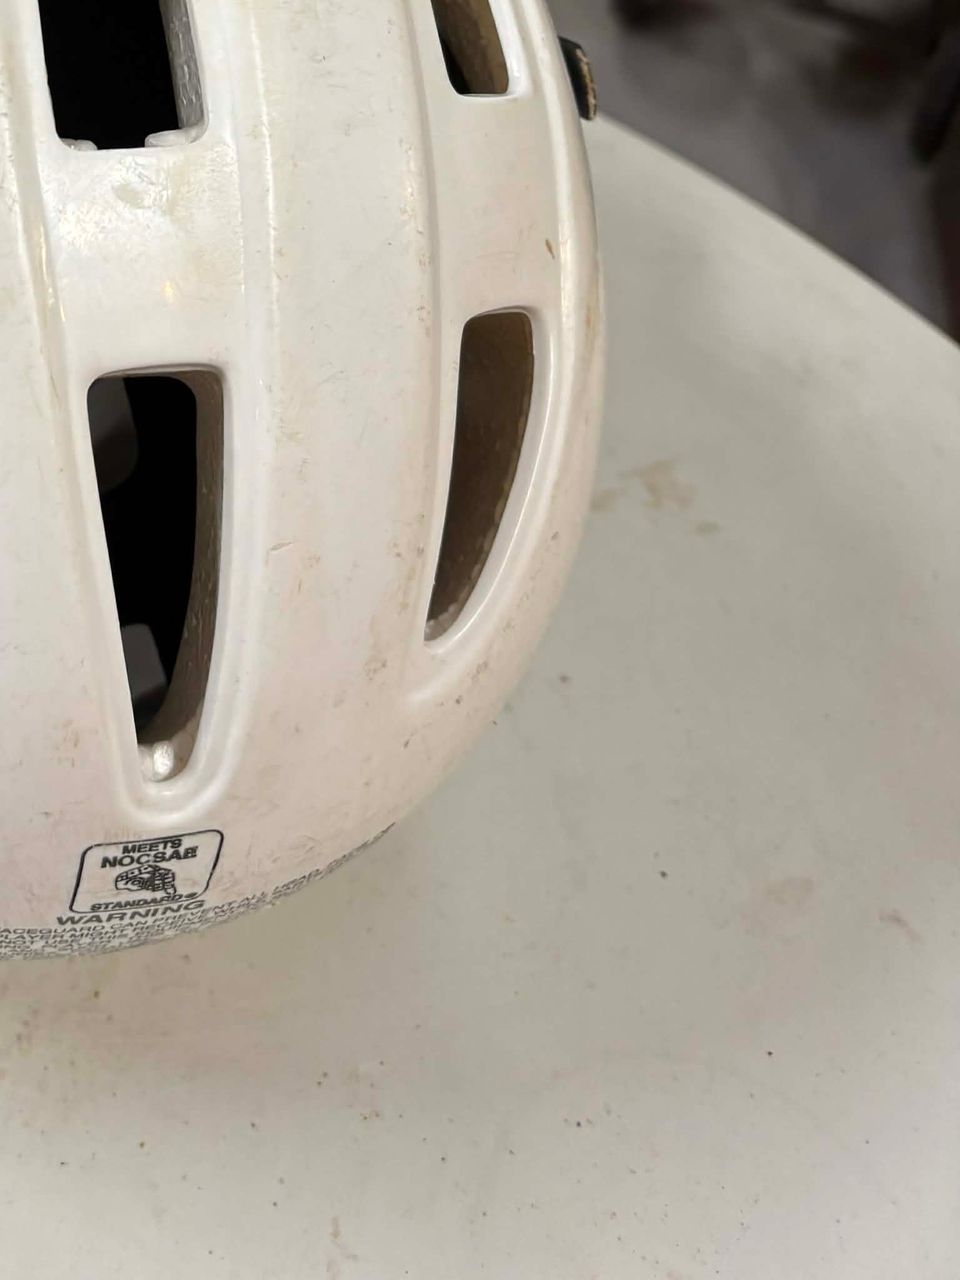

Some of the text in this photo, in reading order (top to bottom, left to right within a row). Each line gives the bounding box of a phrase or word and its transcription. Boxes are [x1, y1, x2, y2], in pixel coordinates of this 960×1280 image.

[122, 838, 183, 855] MEETS
[56, 899, 206, 926] WARNING
[110, 919, 149, 931] CAN
